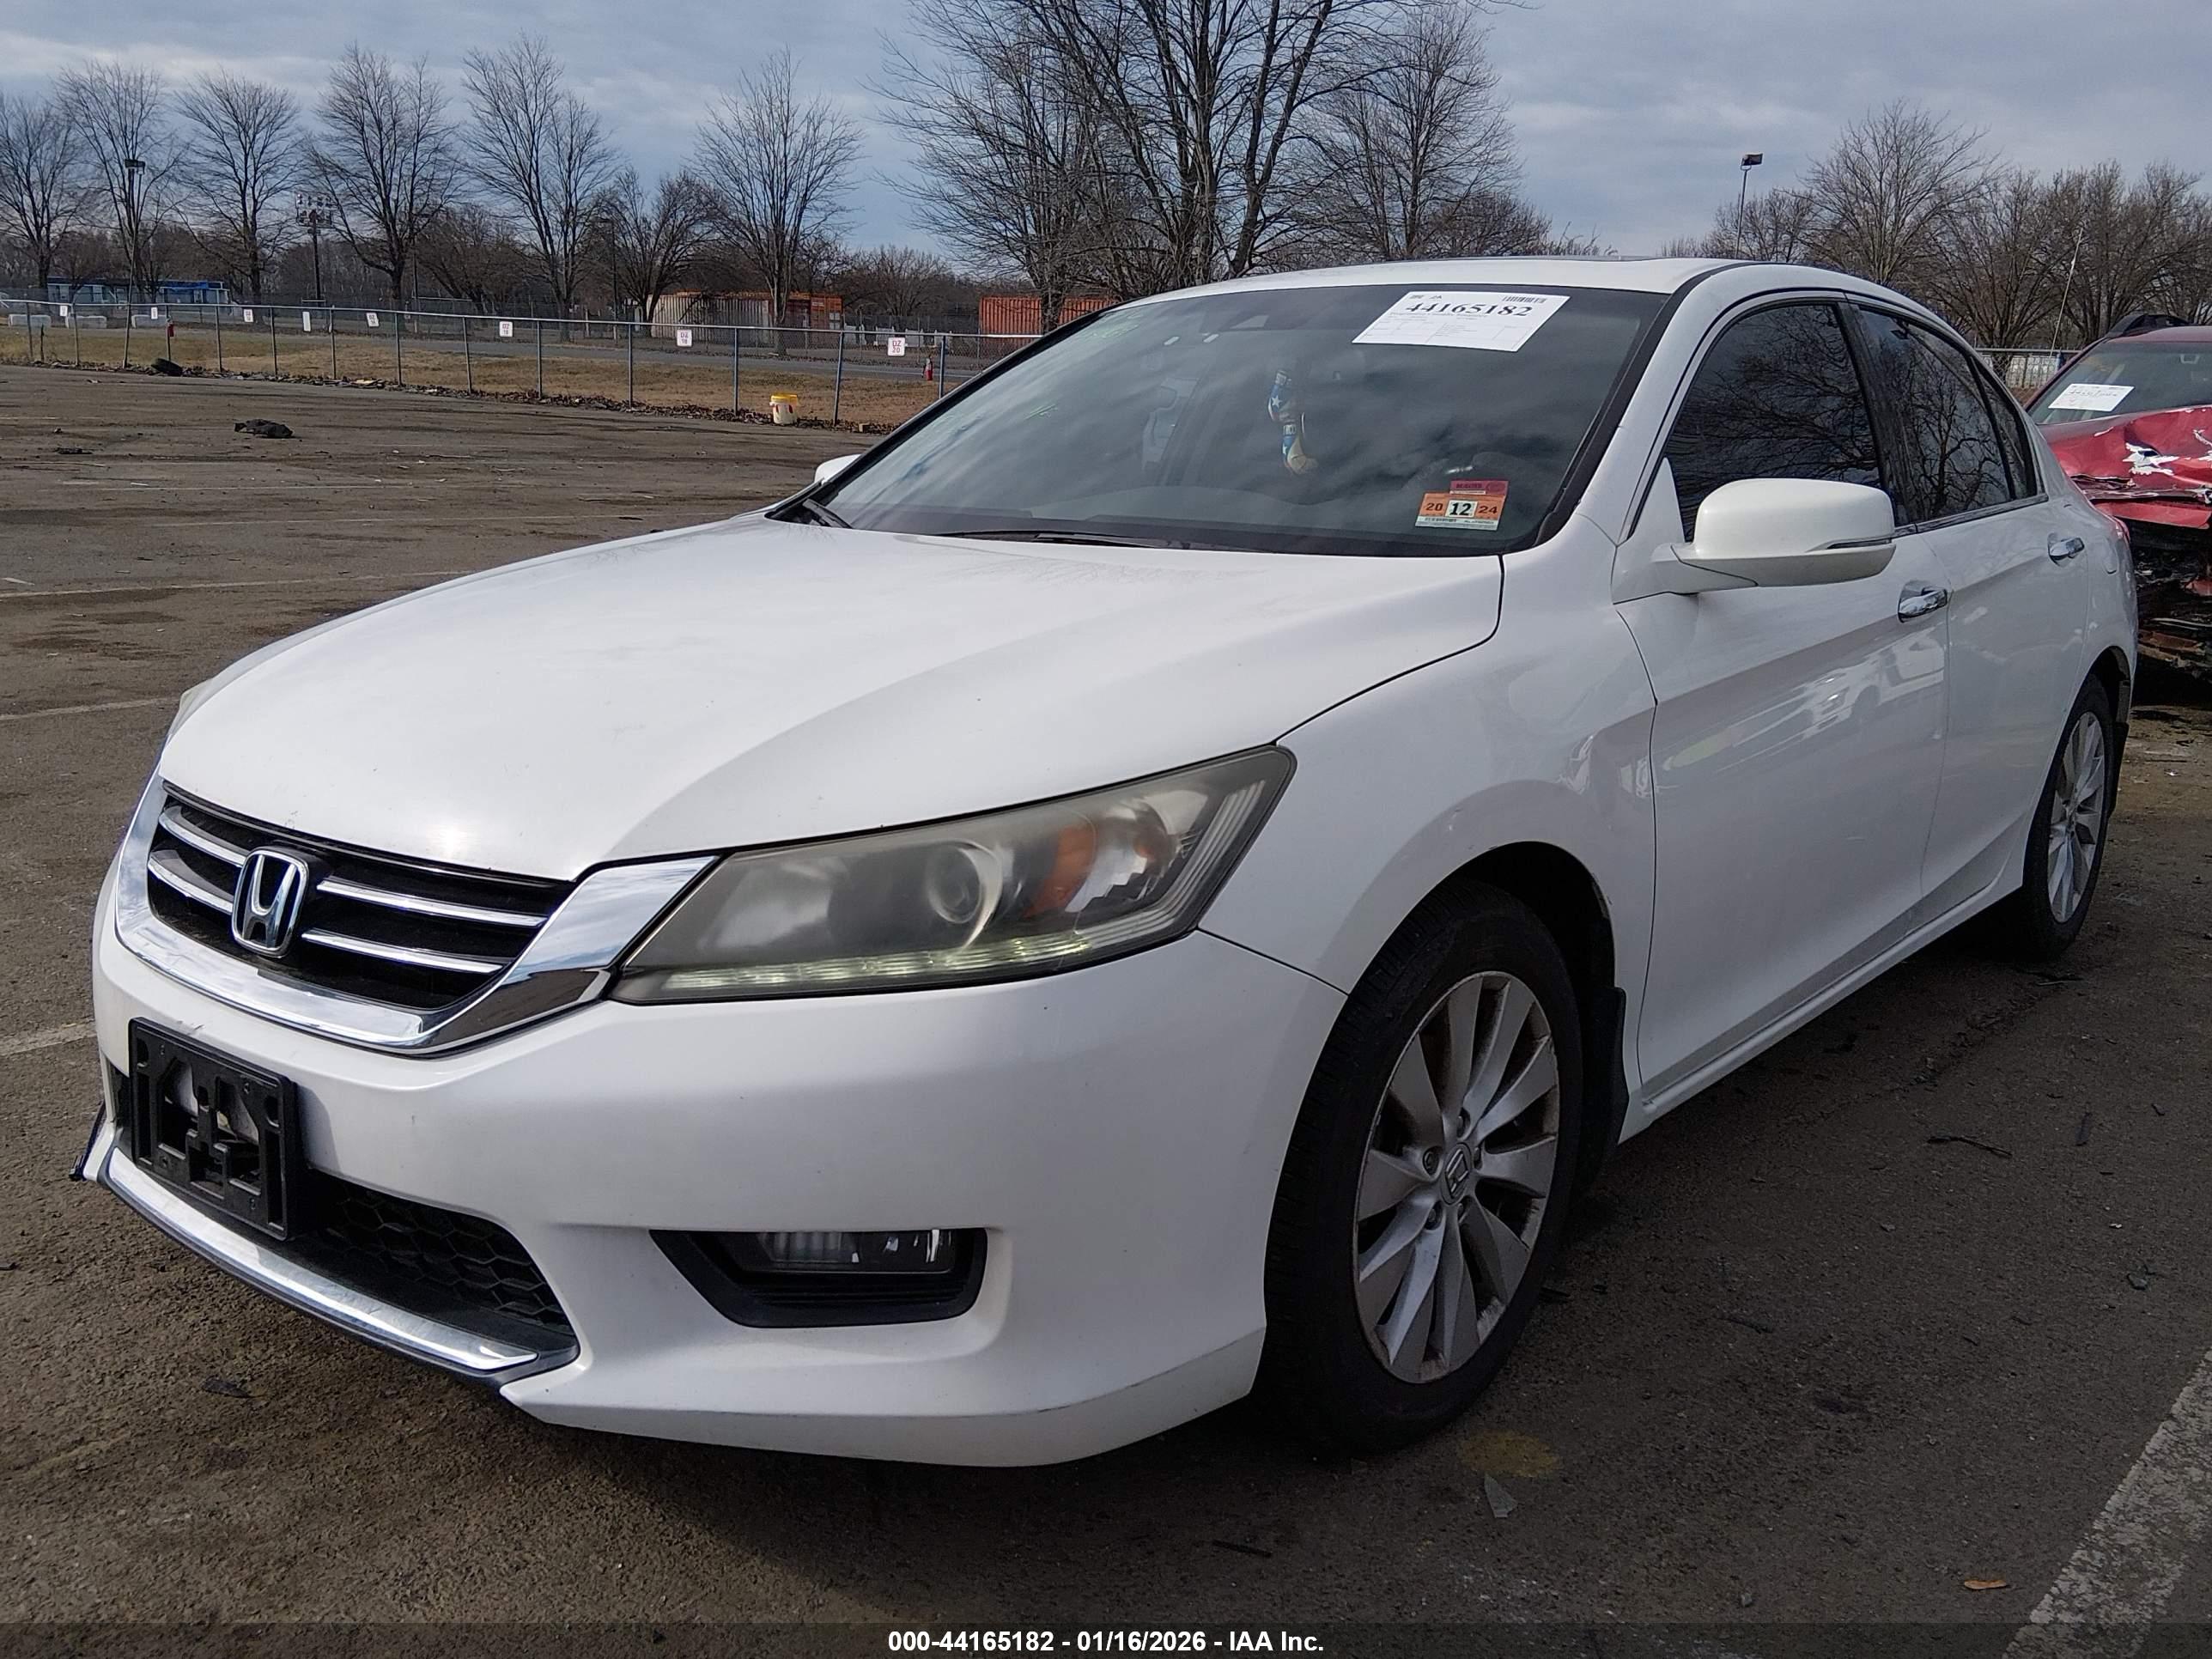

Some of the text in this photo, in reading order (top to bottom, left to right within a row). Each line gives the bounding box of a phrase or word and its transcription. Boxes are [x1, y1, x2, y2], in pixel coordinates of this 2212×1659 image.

[1406, 303, 1534, 316] 44165182
[1425, 502, 1498, 515] 20 12 24
